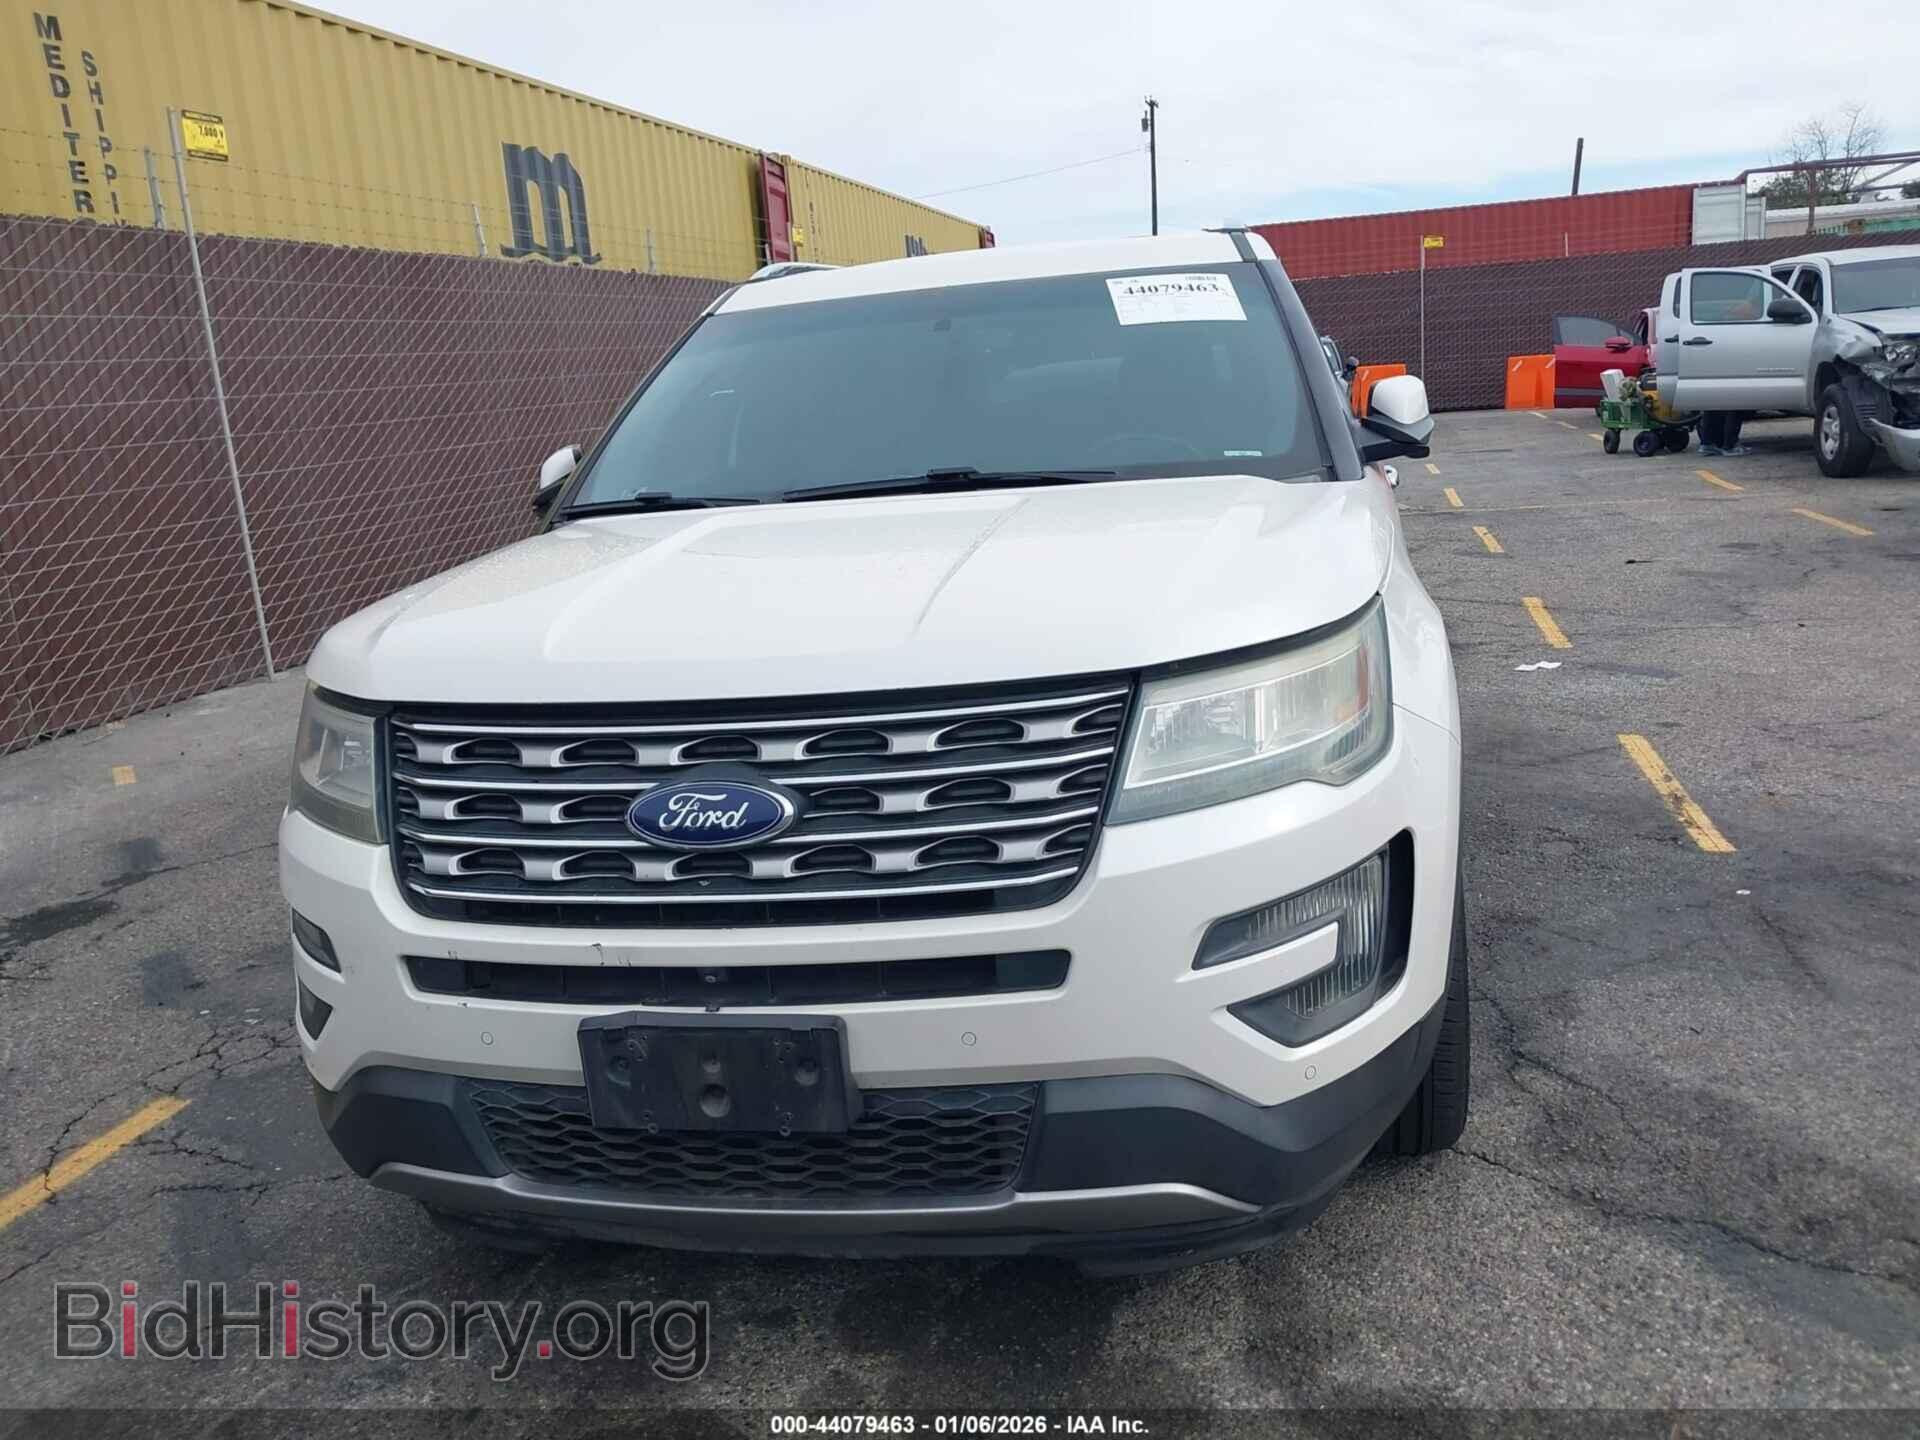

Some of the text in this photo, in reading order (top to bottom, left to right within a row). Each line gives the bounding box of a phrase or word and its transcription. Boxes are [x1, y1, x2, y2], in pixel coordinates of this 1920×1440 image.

[34, 12, 97, 223] MEDITER
[81, 50, 127, 225] SHIPPI
[1123, 283, 1219, 295] 44079463
[658, 793, 749, 831] Ford
